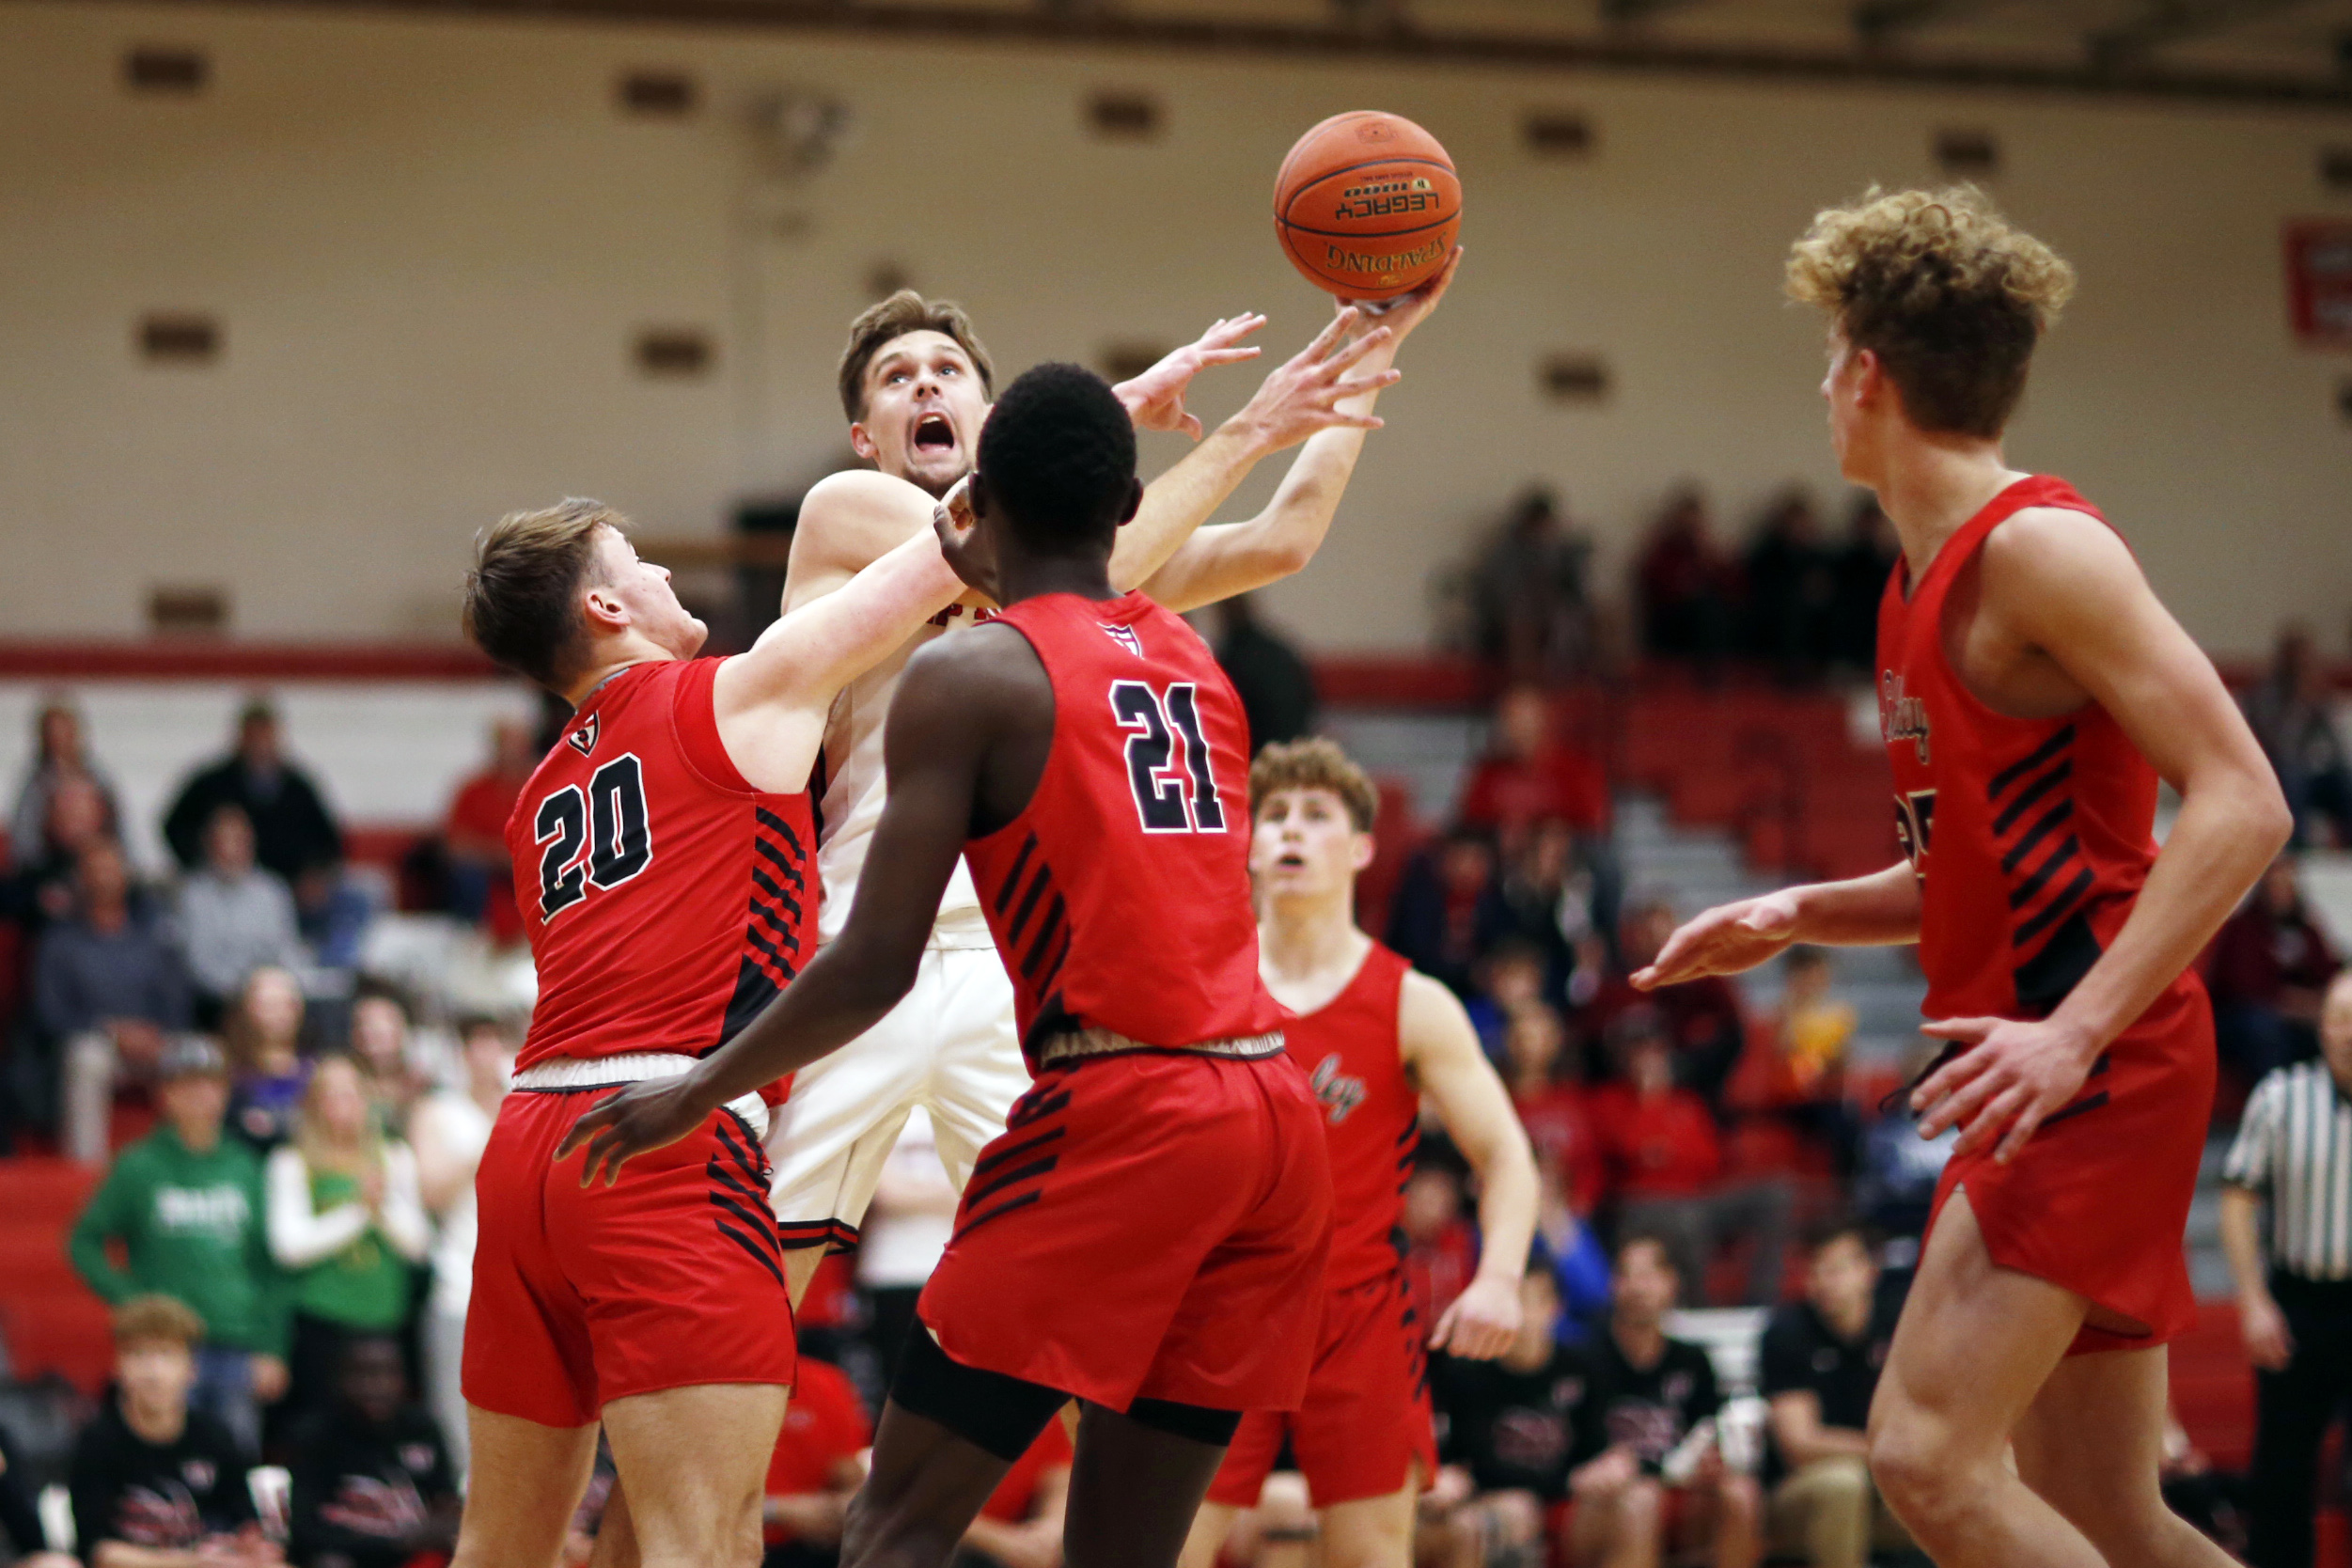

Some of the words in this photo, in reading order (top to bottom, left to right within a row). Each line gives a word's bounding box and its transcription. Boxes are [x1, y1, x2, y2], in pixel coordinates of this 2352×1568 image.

[1335, 193, 1439, 220] LEGACY
[1326, 231, 1448, 273] SPALDING
[1108, 679, 1228, 834] 21
[534, 751, 654, 926] 20
[1310, 1053, 1370, 1123] ley
